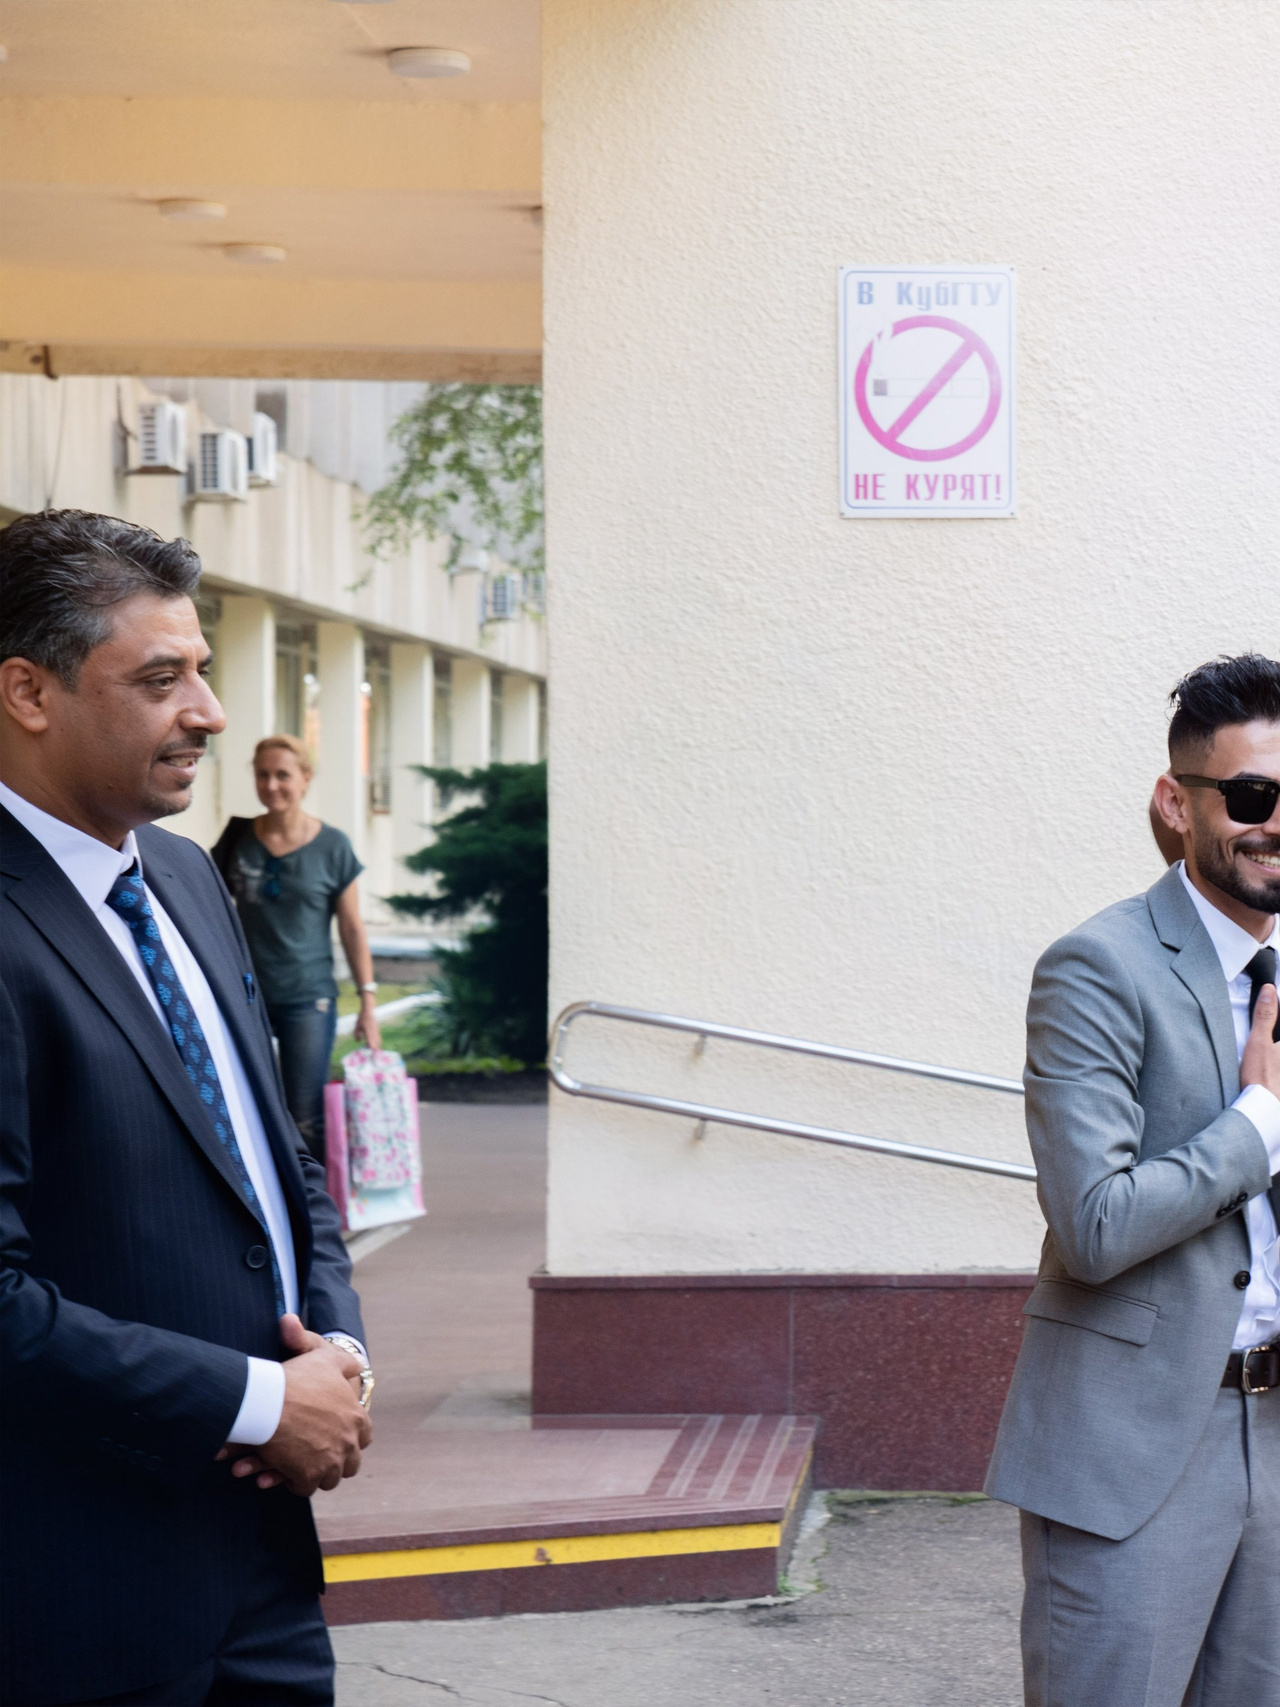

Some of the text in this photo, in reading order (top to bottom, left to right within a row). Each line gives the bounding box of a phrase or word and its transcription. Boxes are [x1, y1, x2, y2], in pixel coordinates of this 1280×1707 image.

[857, 281, 1003, 311] В КубГТУ
[854, 473, 1002, 501] НЕ КУРЯТ!
